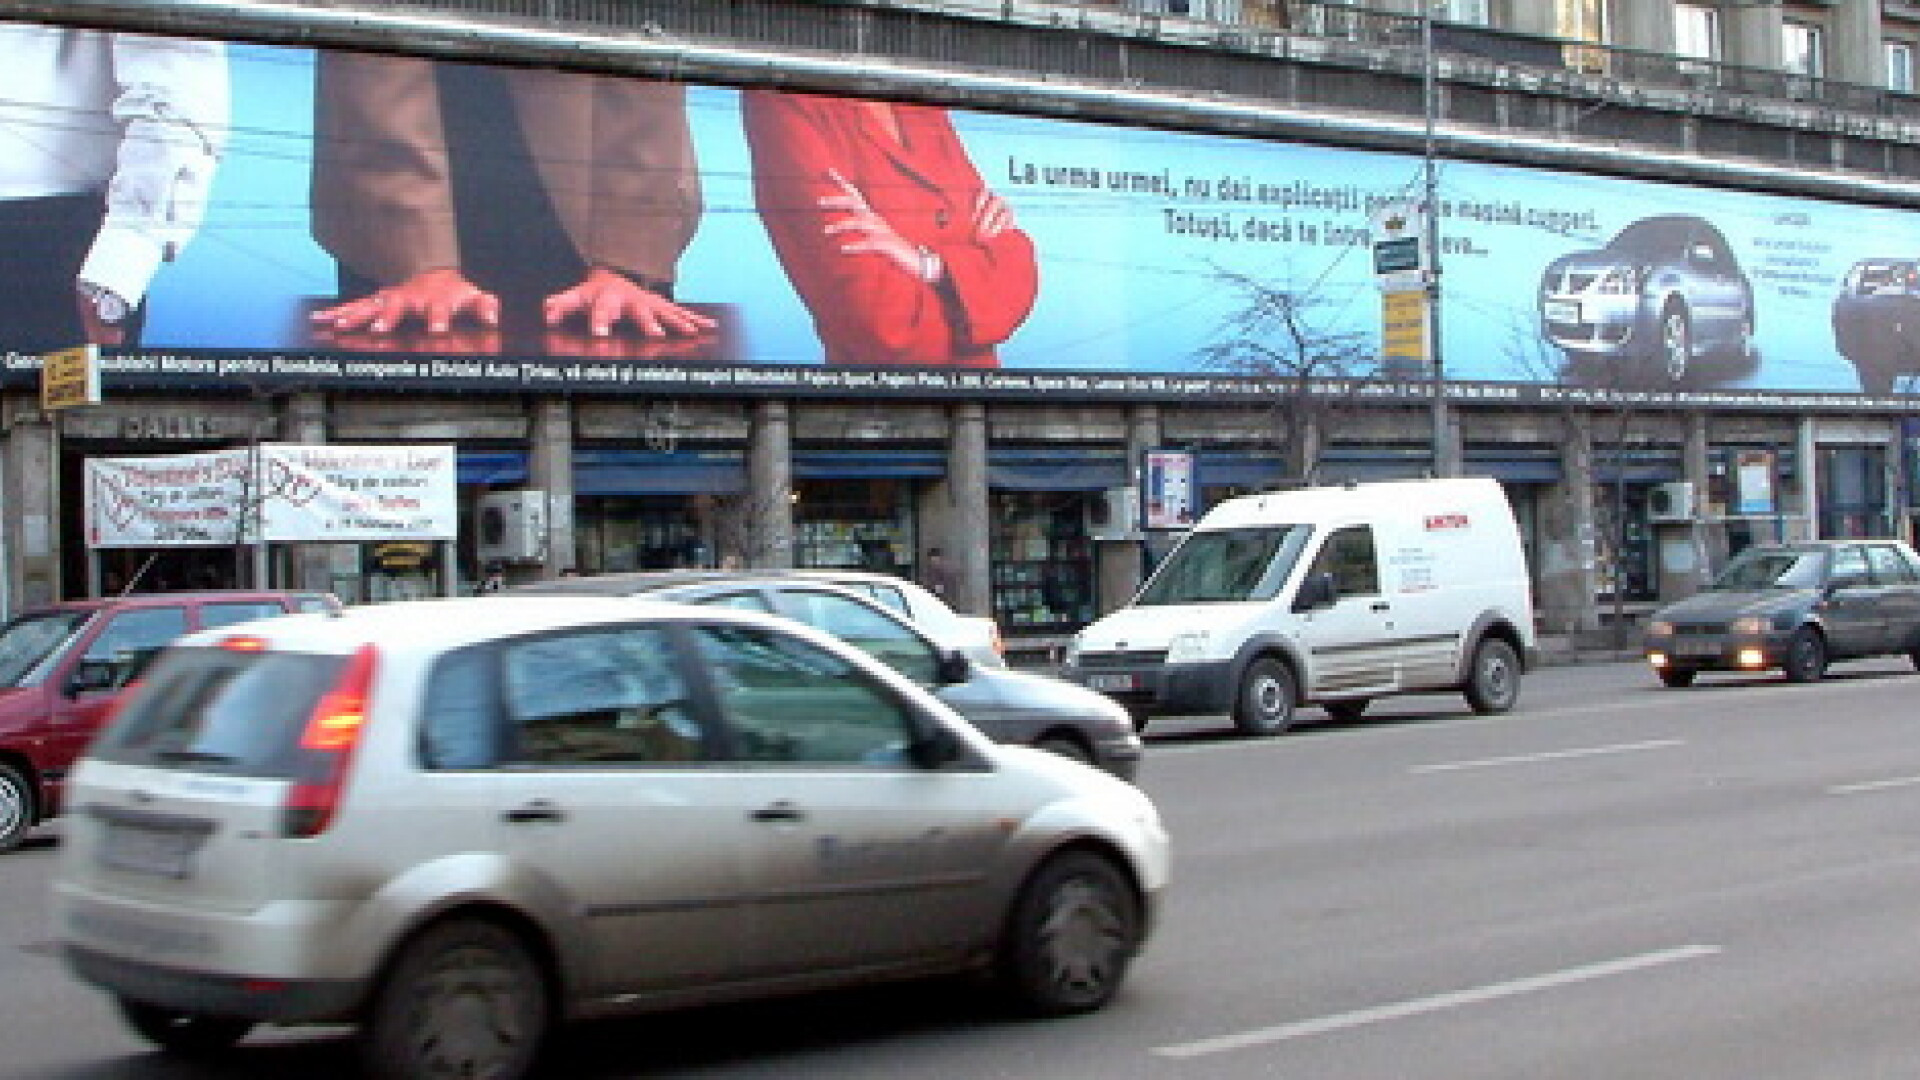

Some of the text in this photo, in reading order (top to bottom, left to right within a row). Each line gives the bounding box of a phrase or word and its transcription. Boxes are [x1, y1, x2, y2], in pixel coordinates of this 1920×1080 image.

[1008, 153, 1038, 188] La
[1041, 168, 1100, 193] urma
[1184, 178, 1210, 200] nu
[1216, 177, 1252, 204] dai
[1297, 220, 1317, 247] te
